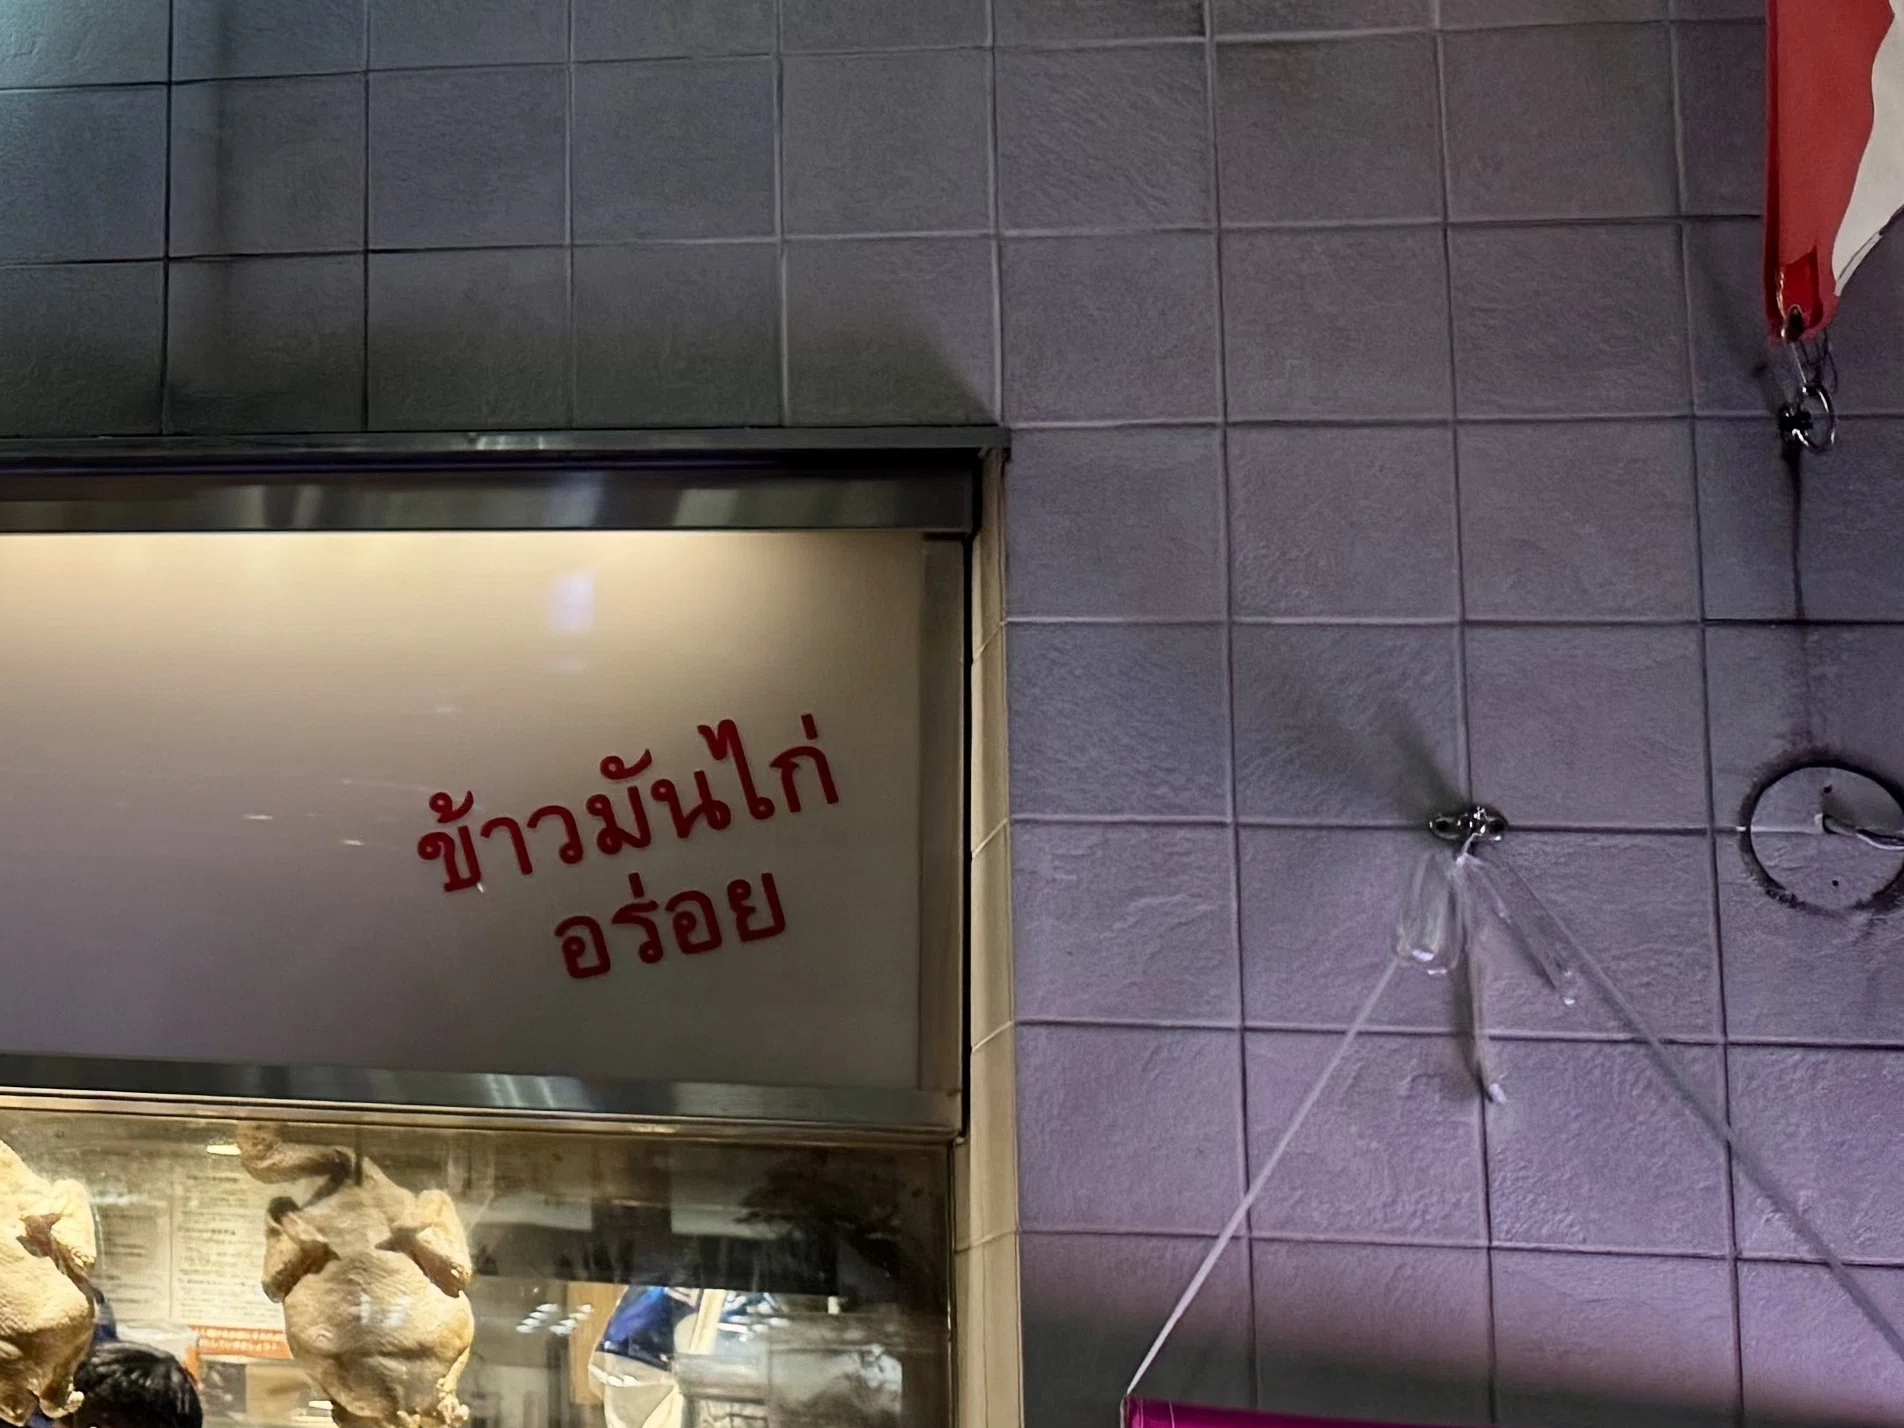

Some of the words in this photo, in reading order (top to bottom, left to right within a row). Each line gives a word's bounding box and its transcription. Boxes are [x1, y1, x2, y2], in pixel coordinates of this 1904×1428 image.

[416, 716, 841, 897] ข้าวมันไก่
[552, 866, 791, 985] อร่อย
